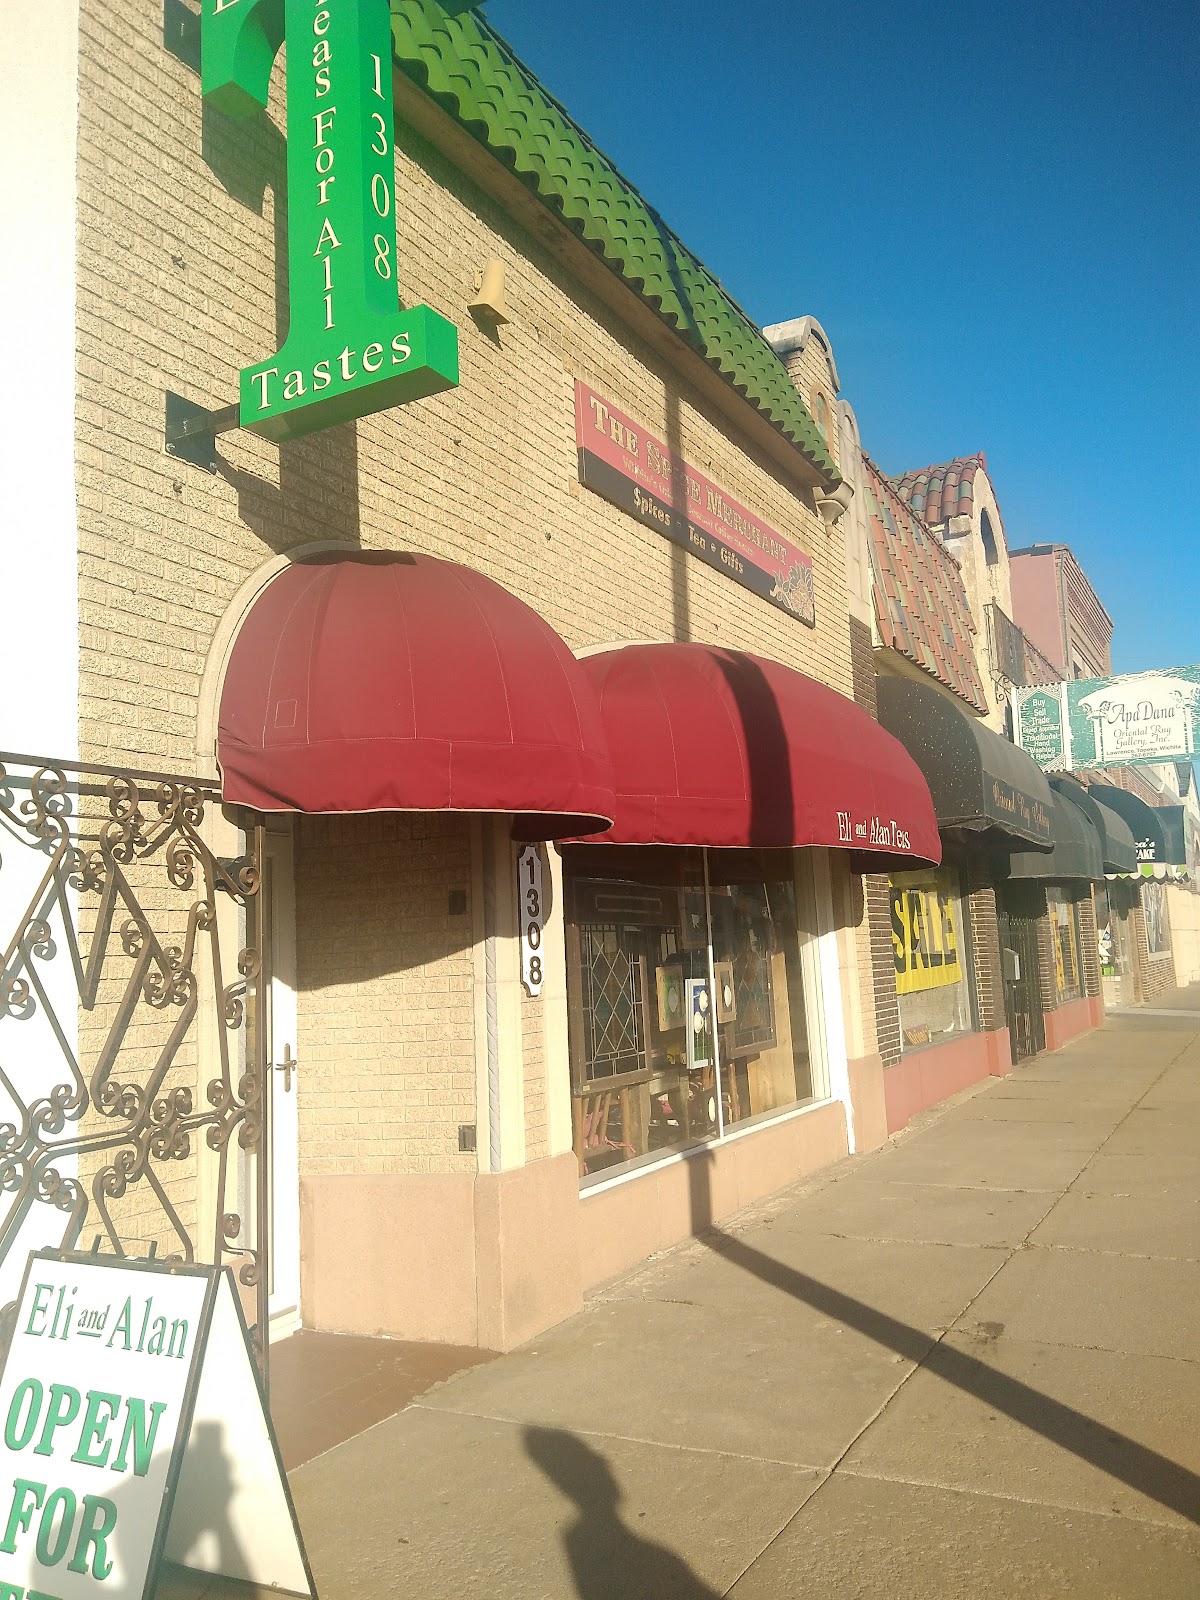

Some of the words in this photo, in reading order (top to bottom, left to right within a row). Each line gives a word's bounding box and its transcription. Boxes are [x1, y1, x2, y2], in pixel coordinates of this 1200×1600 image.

[312, 0, 333, 98] eas
[312, 106, 337, 206] For
[370, 53, 391, 280] 1308
[313, 217, 342, 330] All
[250, 330, 413, 411] Tastes
[589, 395, 639, 459] THE
[705, 484, 787, 565] MERCHANT
[633, 486, 671, 527] Spices
[688, 524, 706, 550] Tea
[720, 546, 744, 574] Gifts
[1031, 717, 1050, 725] Trade
[1032, 699, 1045, 707] Buy
[1033, 708, 1046, 716] Sell
[836, 811, 853, 842] Eli
[855, 820, 867, 838] and
[869, 816, 891, 846] Alan
[526, 856, 542, 985] 1308
[889, 887, 956, 974] SALE
[23, 1283, 78, 1341] Eli
[77, 1304, 112, 1338] and
[106, 1295, 189, 1359] Alan
[4, 1377, 168, 1477] OPEN
[0, 1477, 118, 1581] FOR
